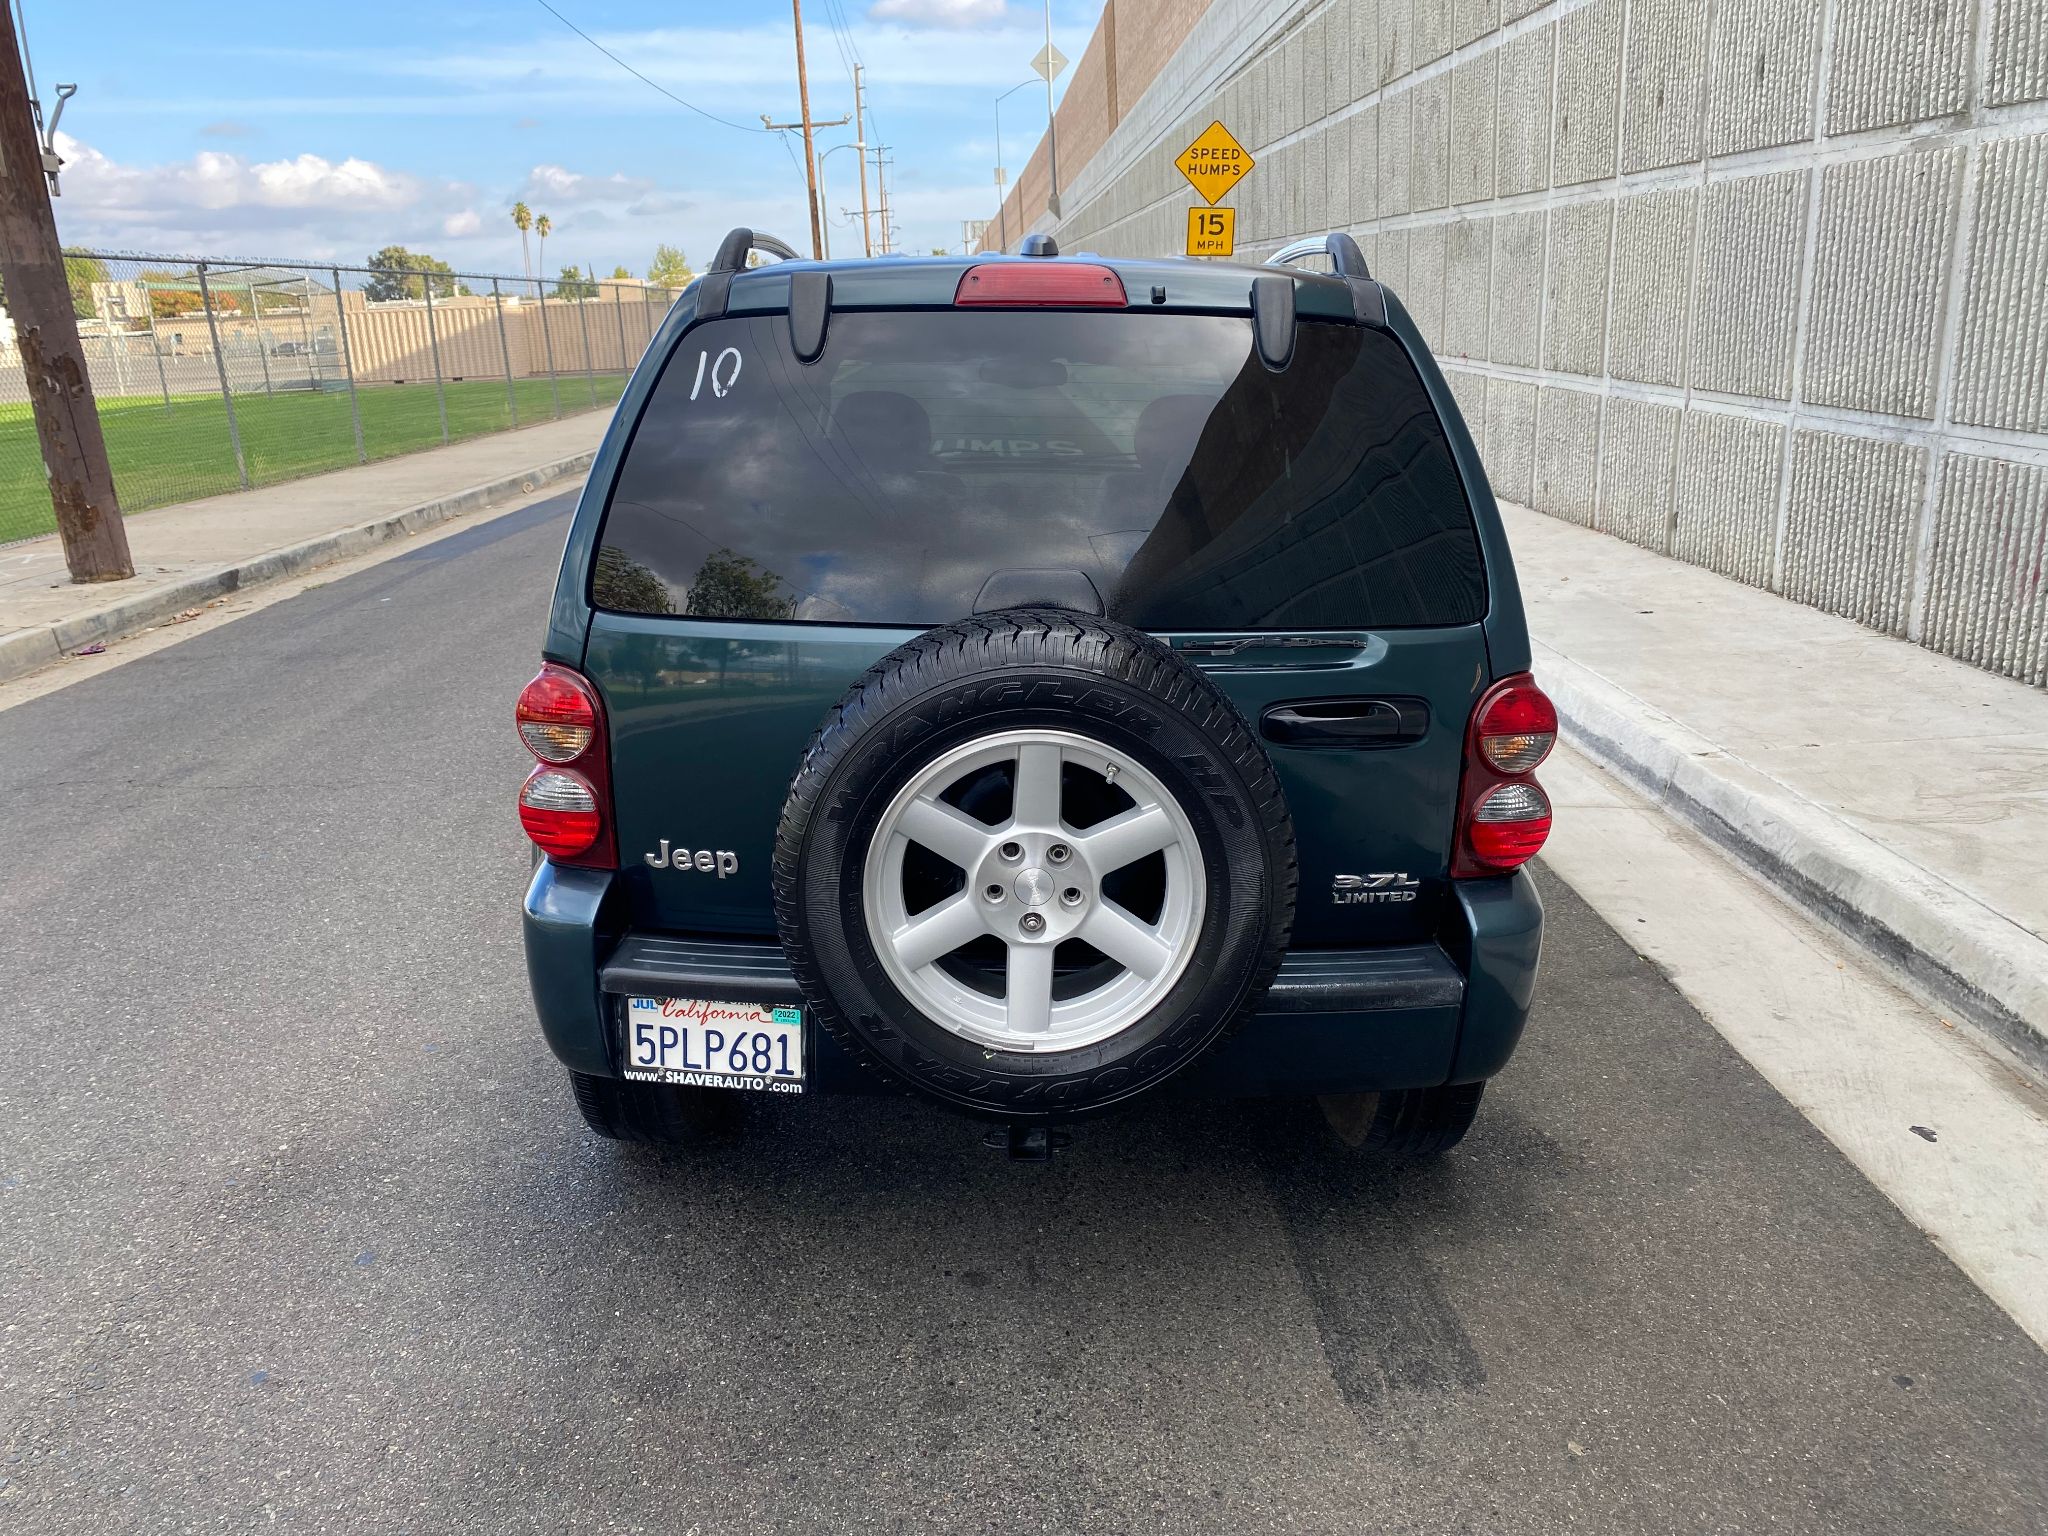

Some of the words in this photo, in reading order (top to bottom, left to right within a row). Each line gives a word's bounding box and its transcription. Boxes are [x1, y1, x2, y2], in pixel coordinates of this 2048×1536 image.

[1190, 148, 1241, 160] SPEED
[1187, 163, 1241, 176] HUMPS
[1198, 213, 1225, 236] 15
[1197, 240, 1224, 250] MPH
[689, 346, 743, 401] 10
[644, 839, 739, 880] Jeep
[1331, 890, 1417, 904] LIMITED
[632, 998, 658, 1010] JUL
[662, 998, 773, 1026] California
[777, 1010, 796, 1019] 2022
[636, 1023, 795, 1076] 5PLP681
